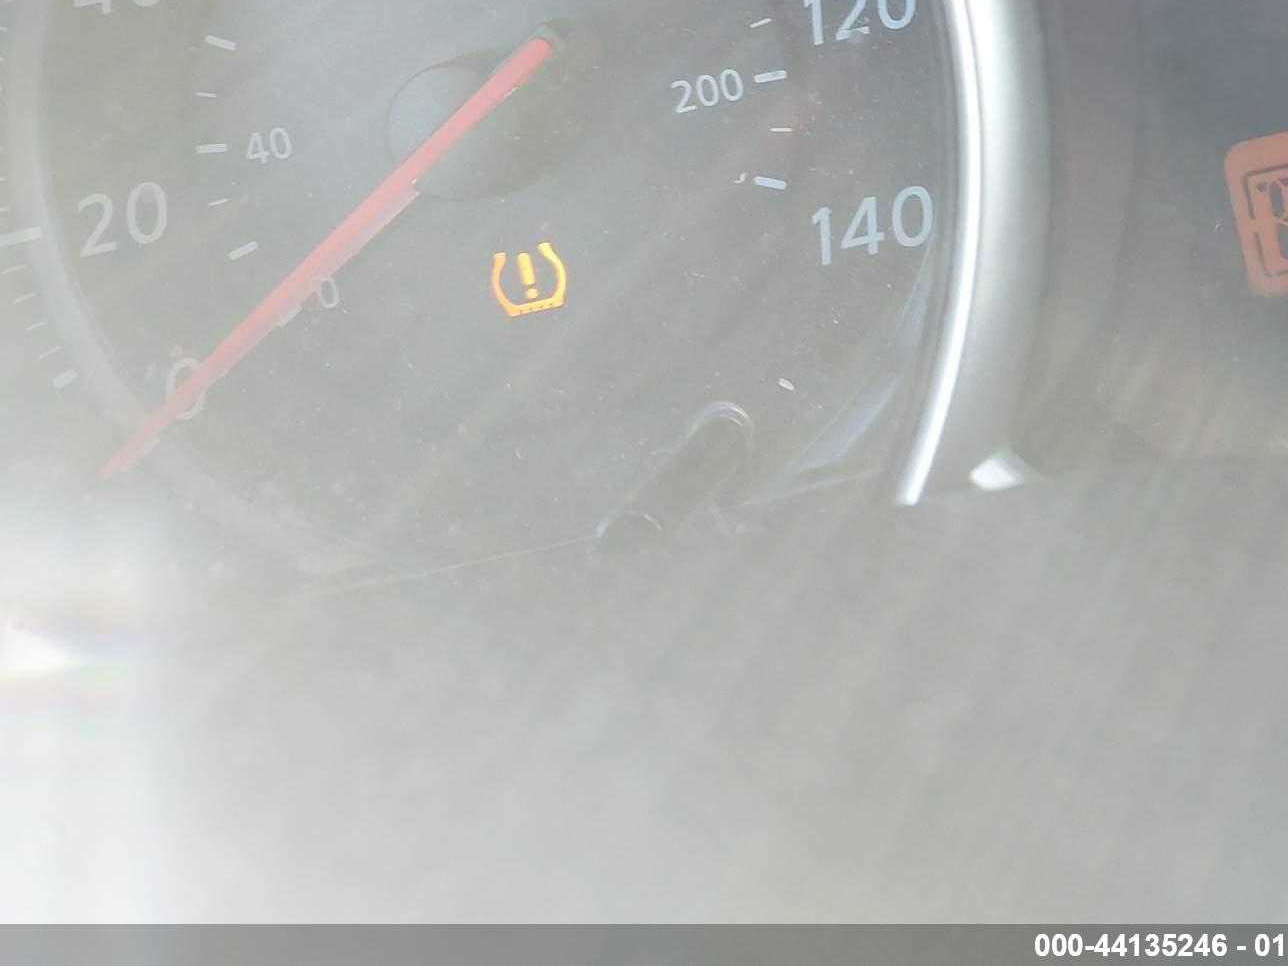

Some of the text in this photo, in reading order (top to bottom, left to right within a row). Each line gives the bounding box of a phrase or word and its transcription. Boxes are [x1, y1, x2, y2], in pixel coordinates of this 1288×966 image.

[670, 68, 745, 114] 200
[244, 126, 293, 164] 40
[77, 181, 169, 258] 20
[811, 185, 934, 267] 140
